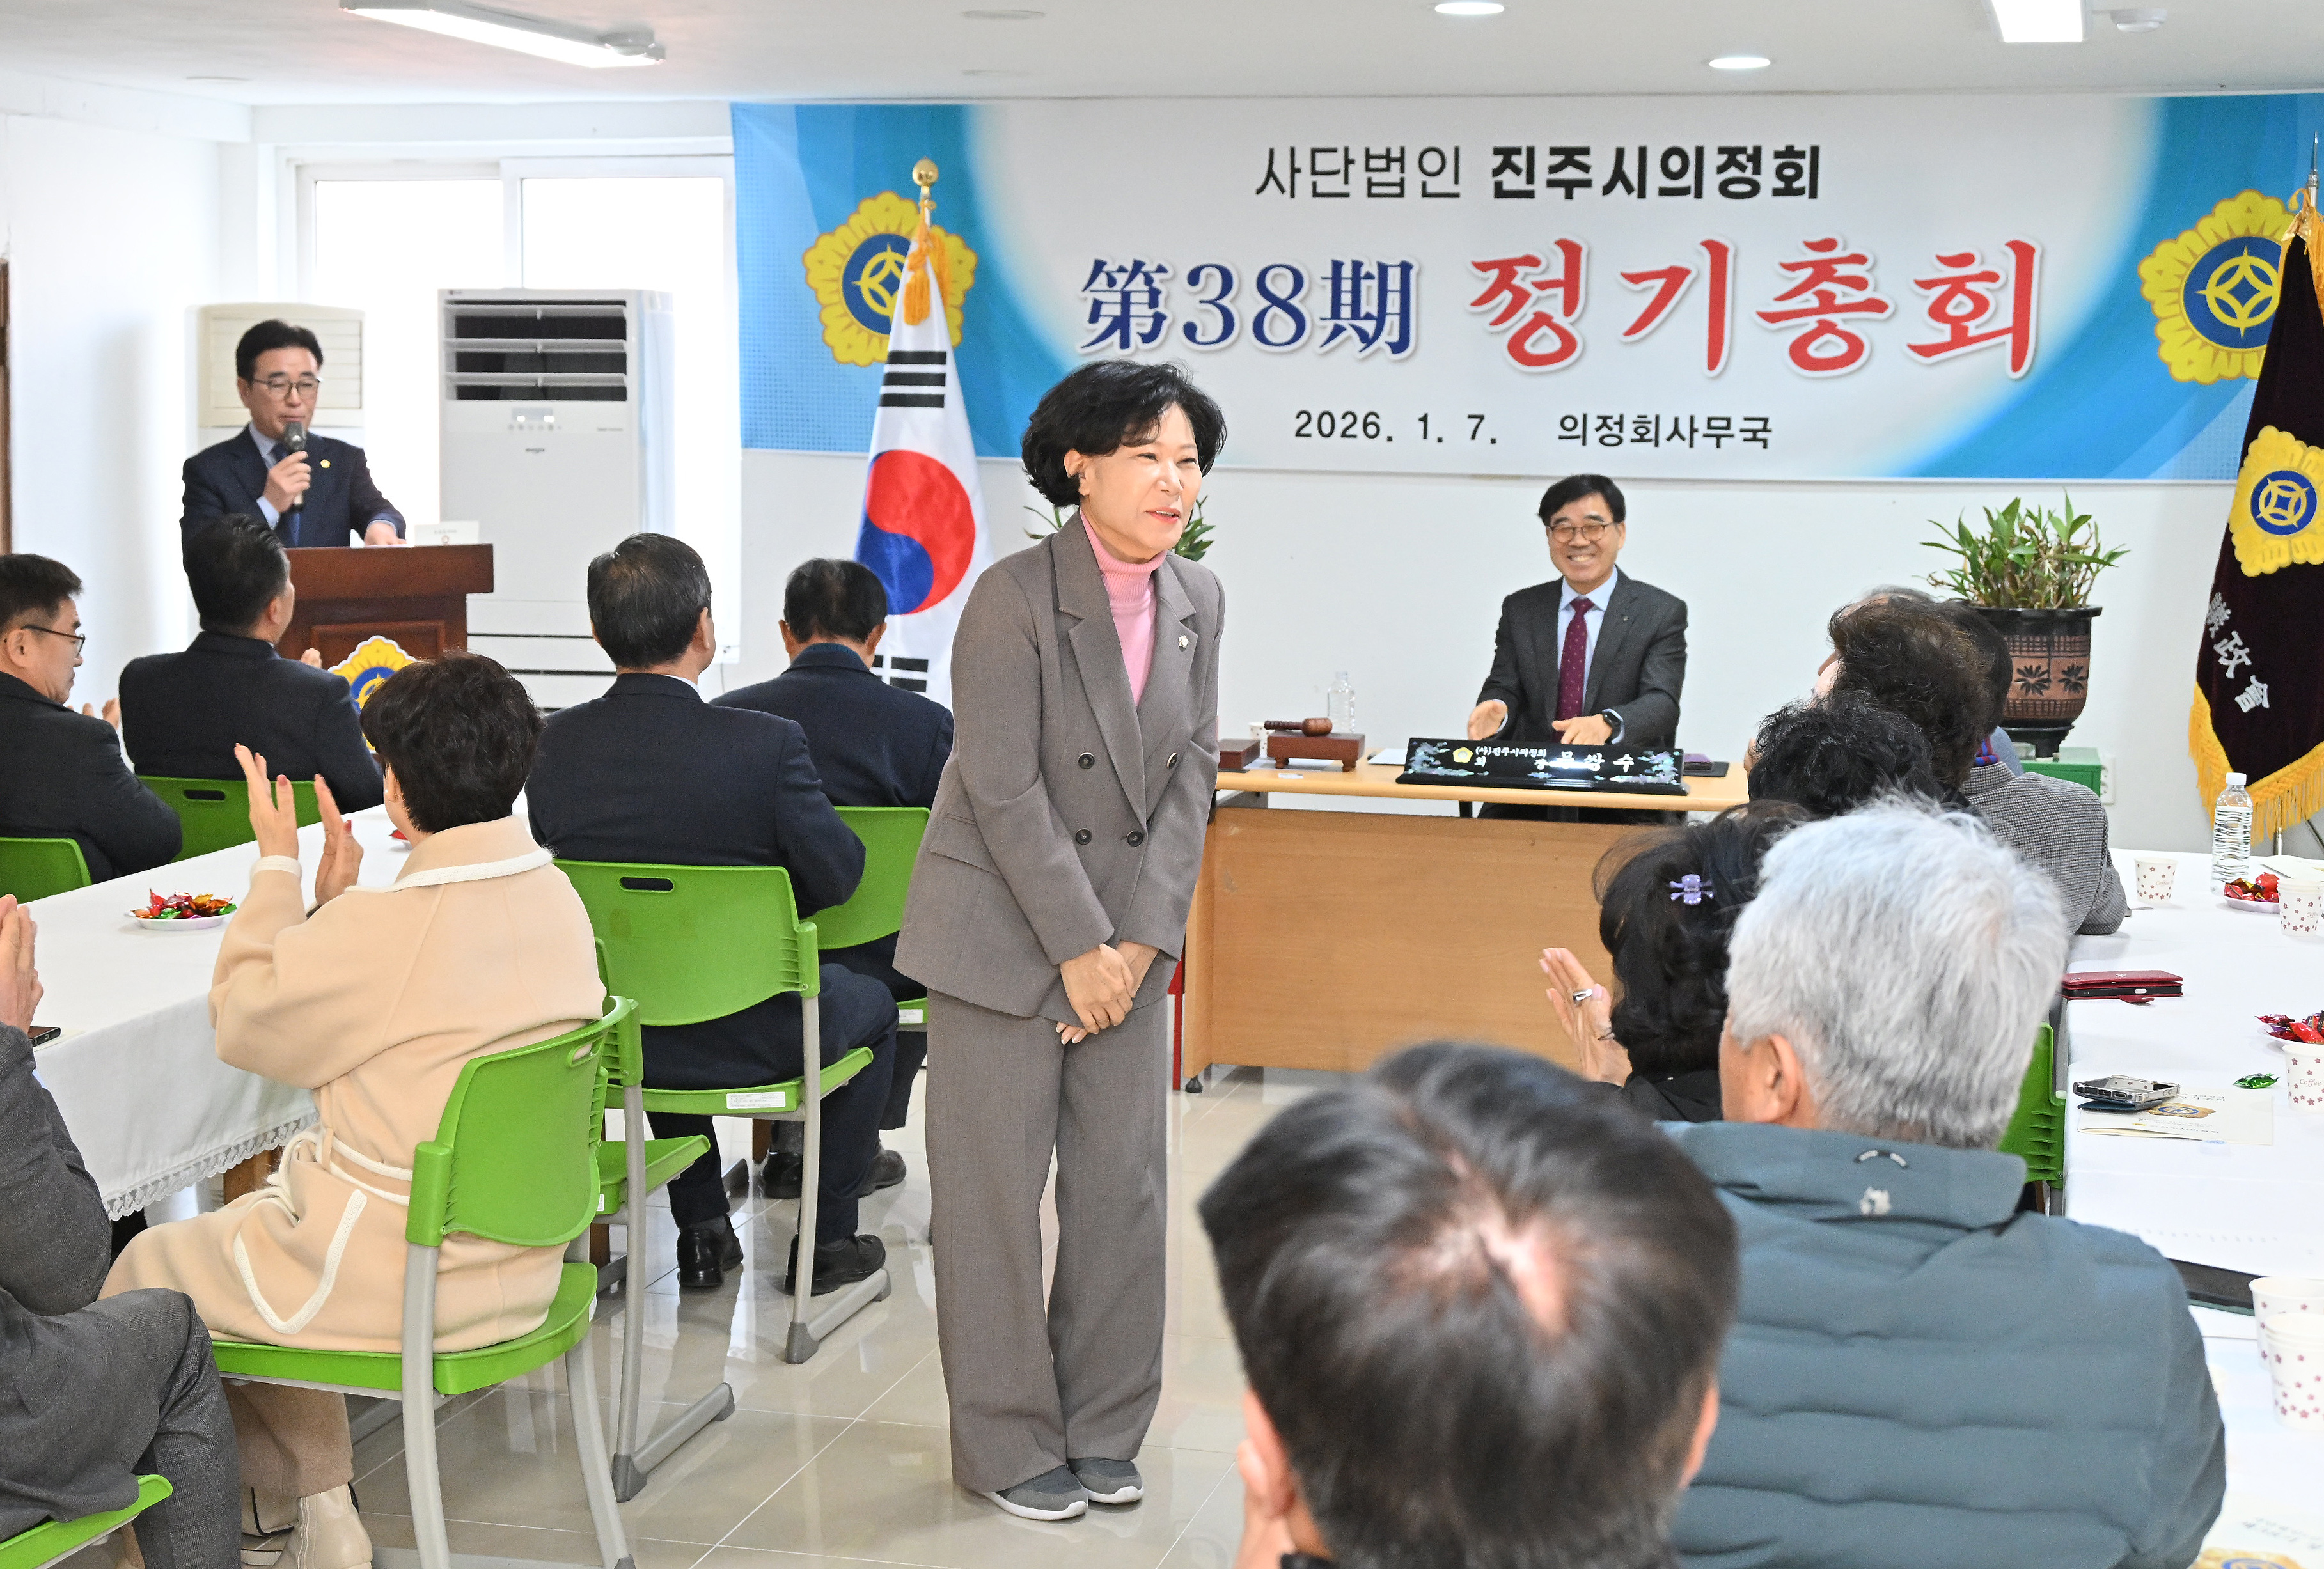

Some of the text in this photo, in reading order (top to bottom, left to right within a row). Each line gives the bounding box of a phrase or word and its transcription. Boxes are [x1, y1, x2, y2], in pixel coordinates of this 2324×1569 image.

[1255, 144, 1819, 200] 사단법인 진주시의정회
[1080, 258, 1413, 354] 第38期
[1471, 238, 2036, 373] 정기총회
[1295, 410, 1496, 444] 2026. 1. 7.
[1558, 413, 1772, 449] 의정회사무국
[2299, 1078, 2321, 1088] Coffee
